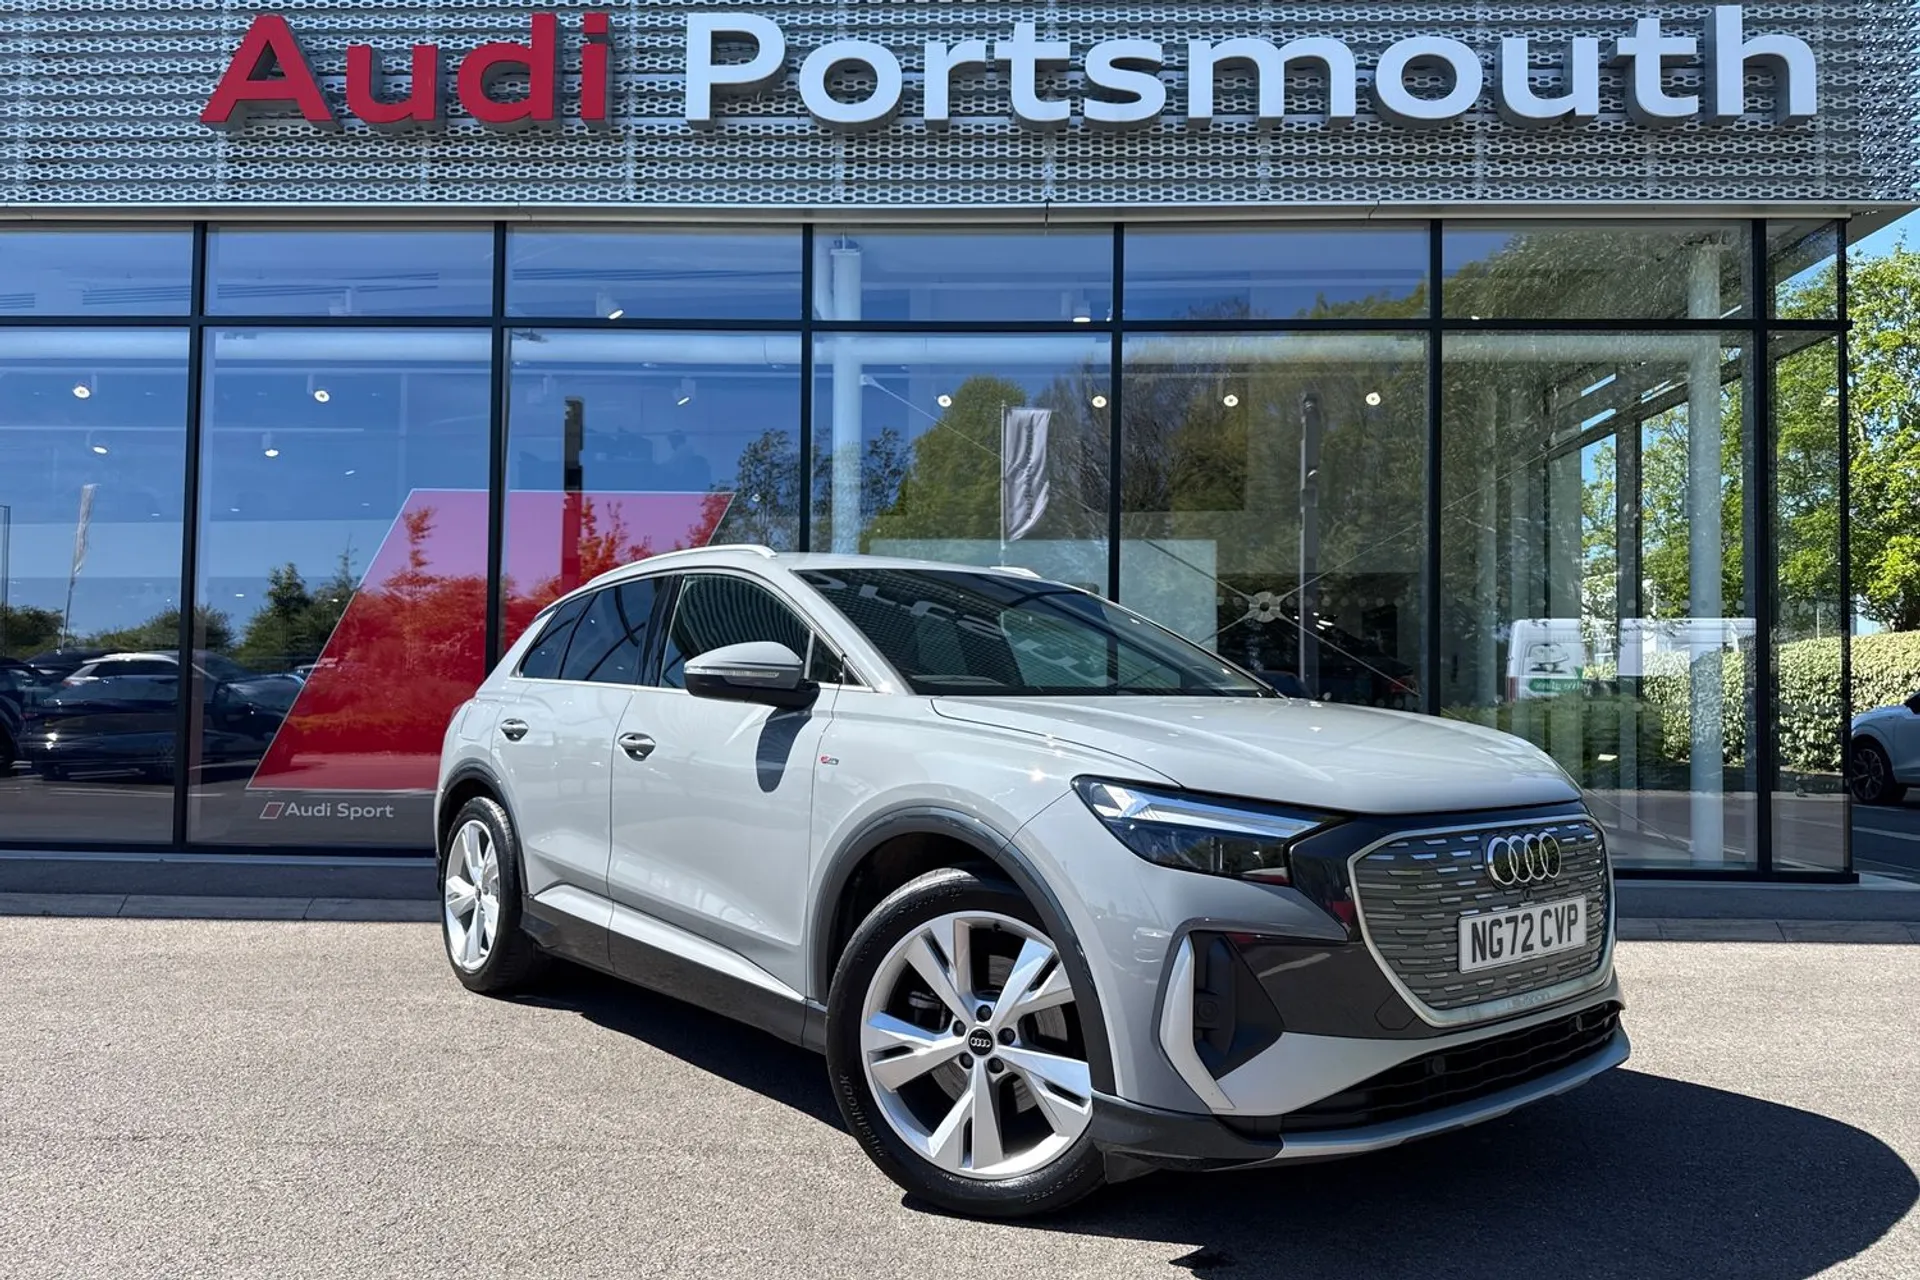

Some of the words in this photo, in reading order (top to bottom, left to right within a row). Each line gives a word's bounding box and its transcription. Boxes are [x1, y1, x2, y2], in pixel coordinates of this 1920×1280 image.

[201, 13, 610, 127] Audi
[685, 4, 1818, 126] Portsmouth
[284, 802, 331, 818] Audi
[337, 802, 394, 820] Sport
[1471, 912, 1535, 963] NG72
[1540, 903, 1579, 948] CVP
